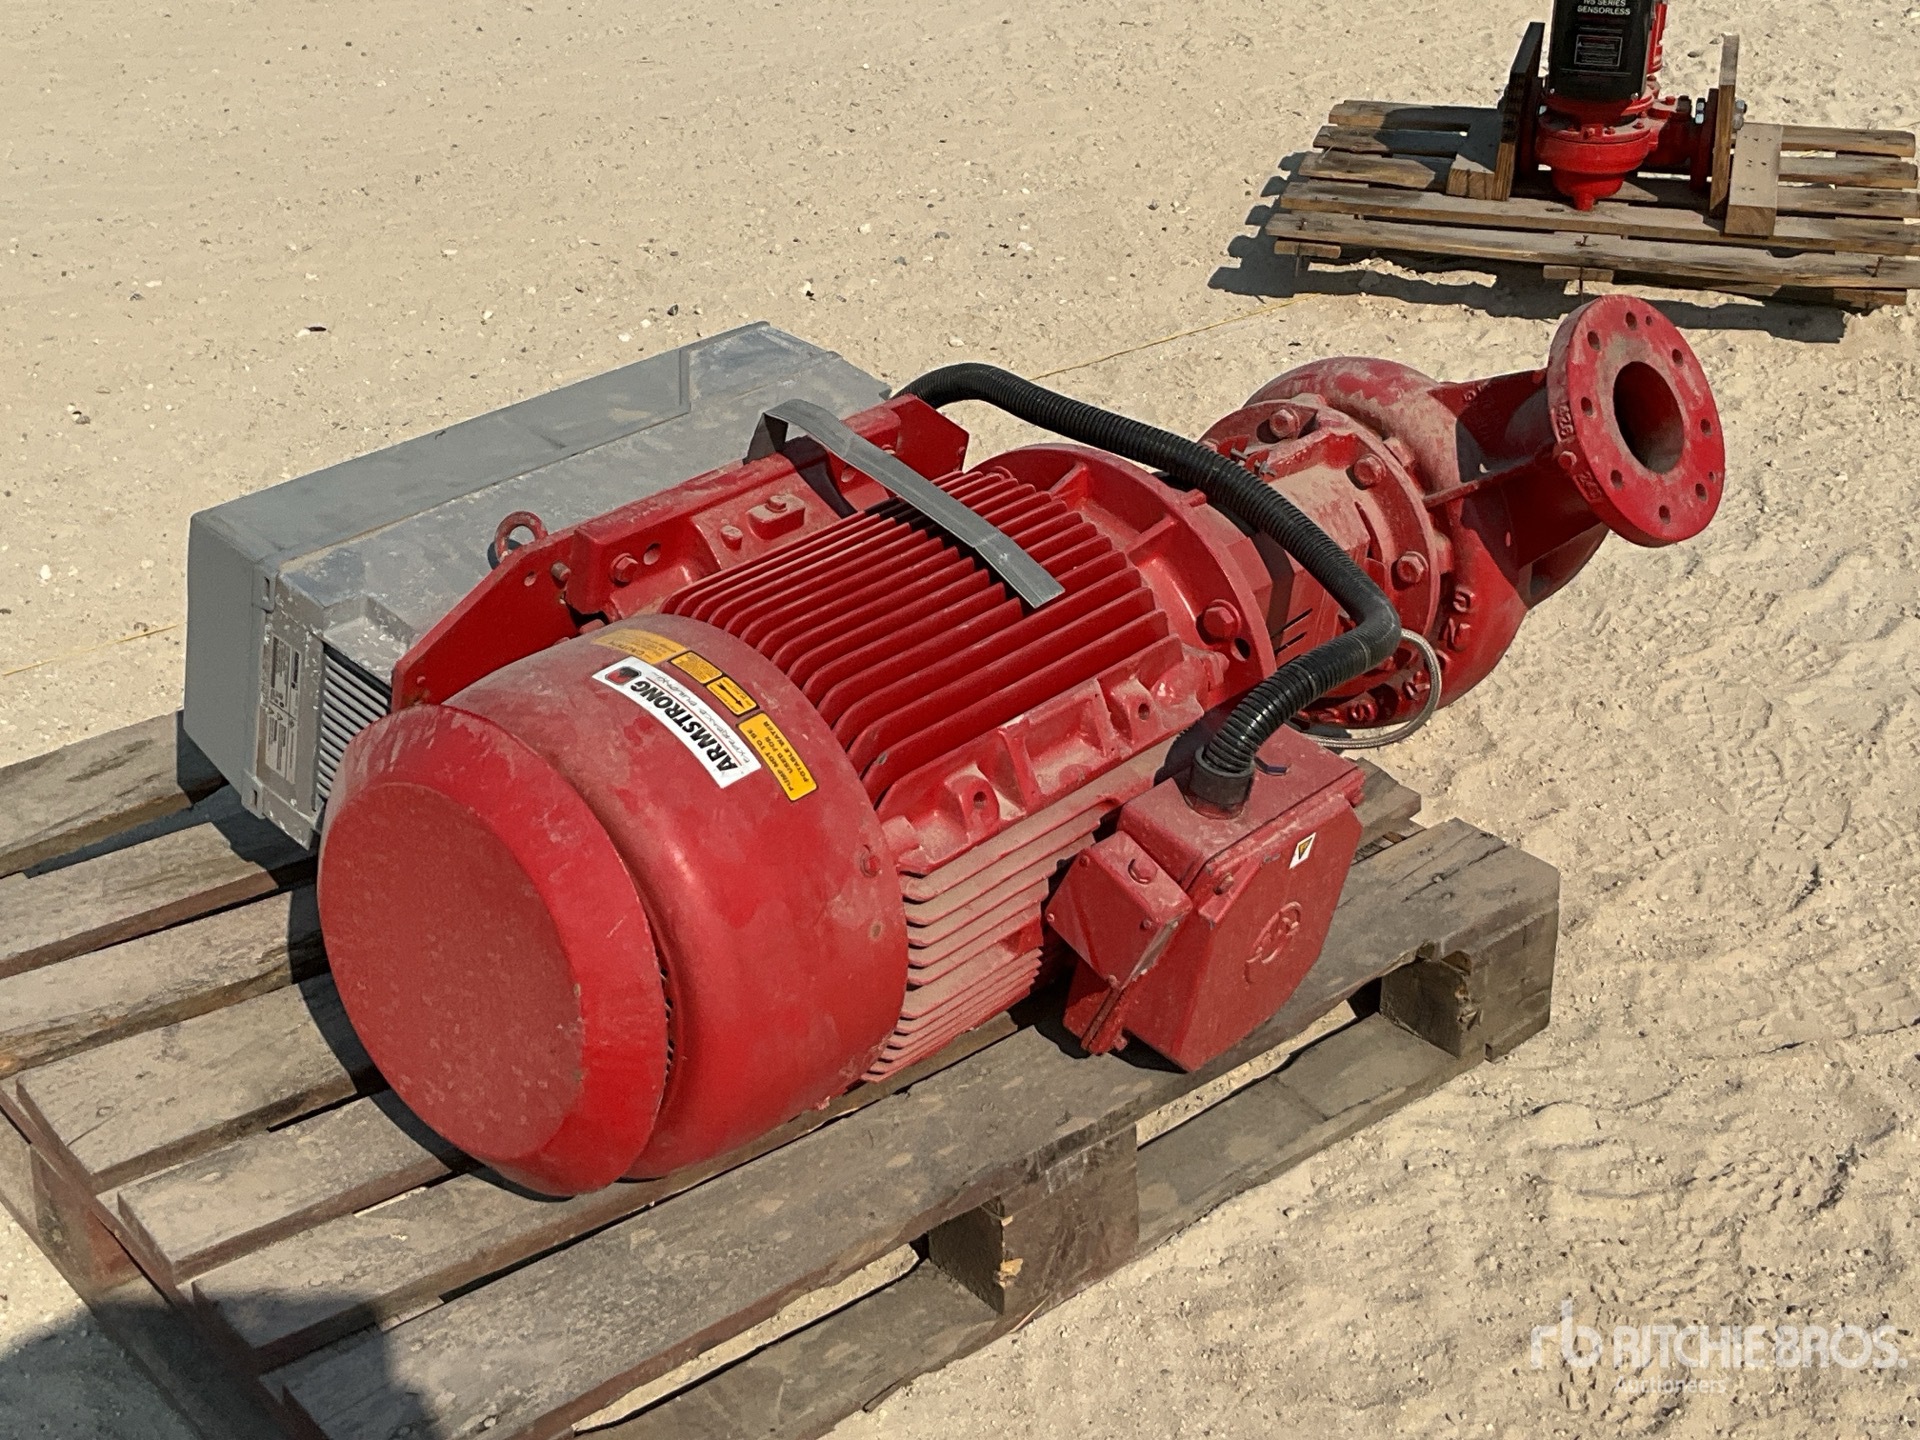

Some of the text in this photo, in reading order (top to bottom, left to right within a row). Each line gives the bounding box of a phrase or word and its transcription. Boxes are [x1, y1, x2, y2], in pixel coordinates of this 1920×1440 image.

[1577, 5, 1631, 16] SENSORLESS
[630, 680, 738, 771] ARMSTRONG
[747, 729, 757, 739] BE
[756, 740, 765, 750] TO
[763, 721, 809, 782] POTABLE WATER
[765, 736, 793, 774] USED FOR
[777, 769, 794, 791] PUMP
